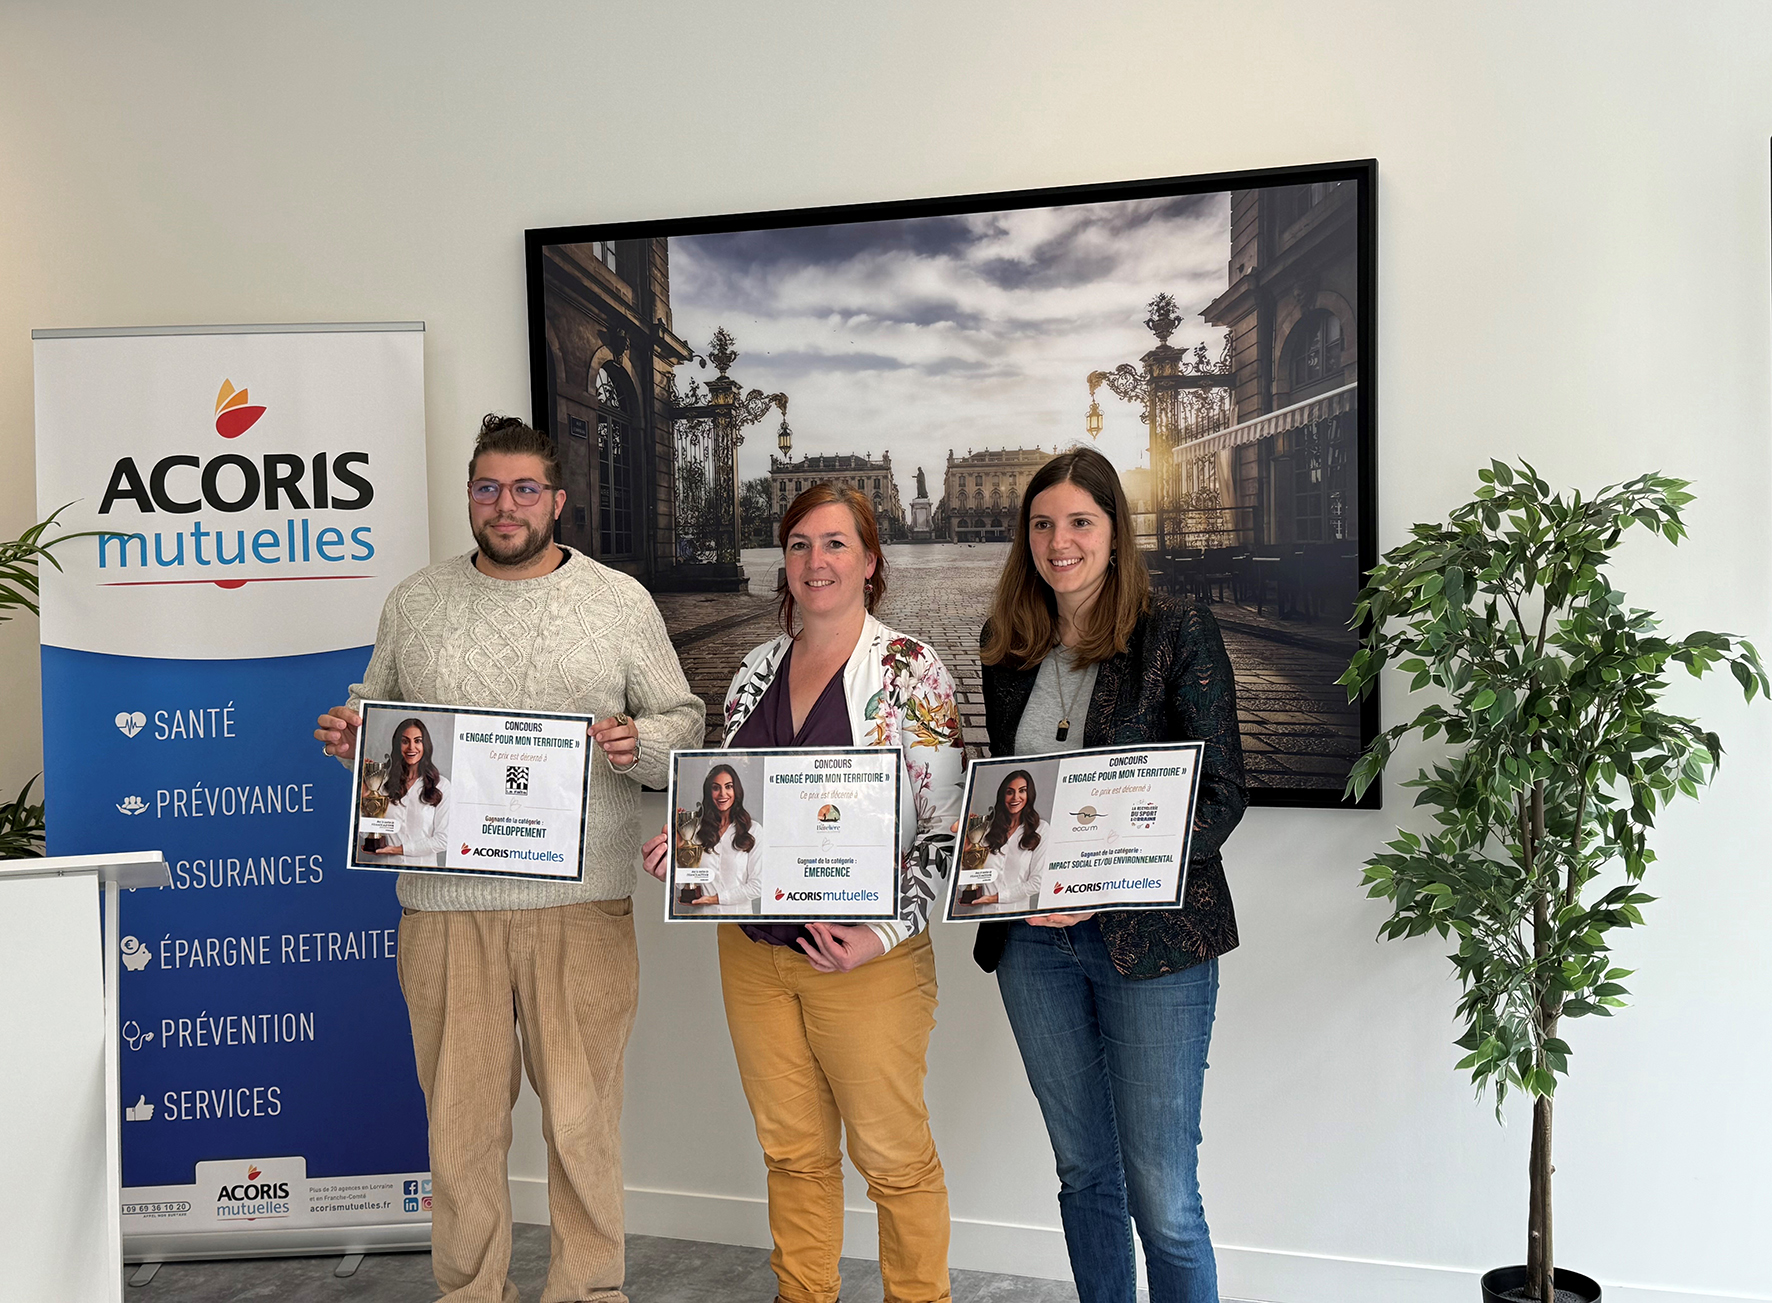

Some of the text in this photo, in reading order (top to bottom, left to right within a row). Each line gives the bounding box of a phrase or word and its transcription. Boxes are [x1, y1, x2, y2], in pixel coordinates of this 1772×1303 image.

[98, 451, 374, 514] ACORIS
[99, 518, 375, 569] mutuelles
[154, 701, 236, 740] SANTÉ
[505, 721, 542, 732] CONCOURS
[466, 732, 493, 743] ENGAGÉ
[495, 735, 514, 745] POUR
[515, 736, 531, 746] MON
[533, 737, 574, 748] TERRITOIRE
[490, 750, 497, 759] Ce
[498, 751, 508, 761] prix
[510, 752, 519, 760] est
[1109, 755, 1148, 767] CONCOURS
[814, 759, 852, 769] CONCOURS
[776, 772, 803, 784] ENGAGÉ
[805, 774, 823, 783] POUR
[825, 774, 841, 783] MON
[843, 773, 883, 782] TERRITOIRE
[1068, 771, 1096, 783] ENGAGÉ
[1098, 772, 1117, 781] POUR
[1118, 770, 1135, 779] MON
[1137, 767, 1180, 777] TERRITOIRE
[800, 791, 808, 799] Ce
[808, 792, 819, 800] prix
[821, 791, 829, 799] est
[1091, 787, 1099, 796] Ce
[1099, 787, 1110, 797] prix
[1112, 786, 1121, 794] est
[1122, 784, 1146, 793] décerné
[157, 782, 314, 818] PRÉVOYANCE
[485, 815, 505, 823] Gagnant
[518, 818, 541, 826] catégorie
[482, 823, 547, 838] DÉVELOPPEMENT
[1114, 847, 1138, 855] catégorie
[797, 857, 817, 865] Gagnant
[831, 857, 854, 865] catégorie
[1049, 855, 1174, 870] IMPACT SOCIAL ET/OU ENVIRONNEMENTAL
[804, 865, 850, 877] ÉMERGENCE
[160, 929, 396, 969] ÉPARGNE RETRAITE
[161, 1011, 315, 1048] PRÉVENTION
[163, 1087, 282, 1121] SERVICES
[217, 1183, 289, 1202] ACORIS
[324, 1193, 366, 1201] Franche-Comté
[217, 1201, 289, 1216] mutuelles
[310, 1201, 391, 1212] acorismutuelles.fr
